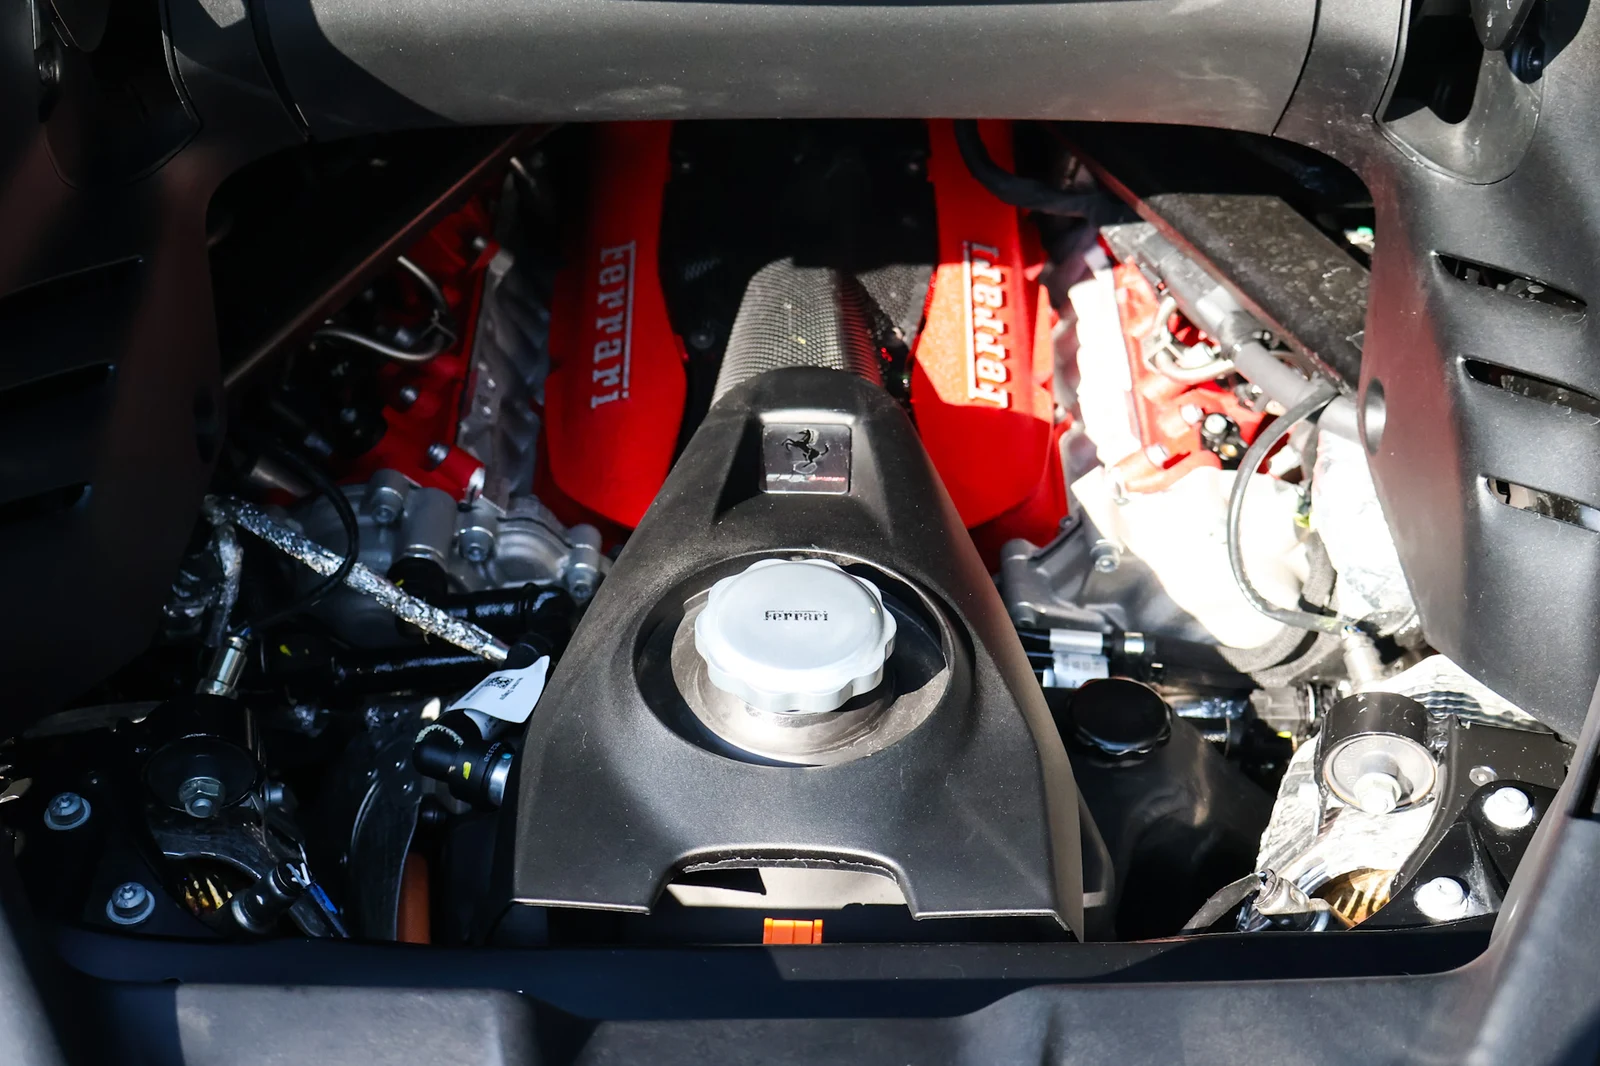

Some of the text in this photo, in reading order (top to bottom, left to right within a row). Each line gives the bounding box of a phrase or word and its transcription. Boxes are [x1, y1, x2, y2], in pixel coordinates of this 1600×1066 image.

[591, 240, 636, 409] Ferrari
[963, 240, 1009, 408] Ferrari
[763, 610, 828, 621] Ferrari
